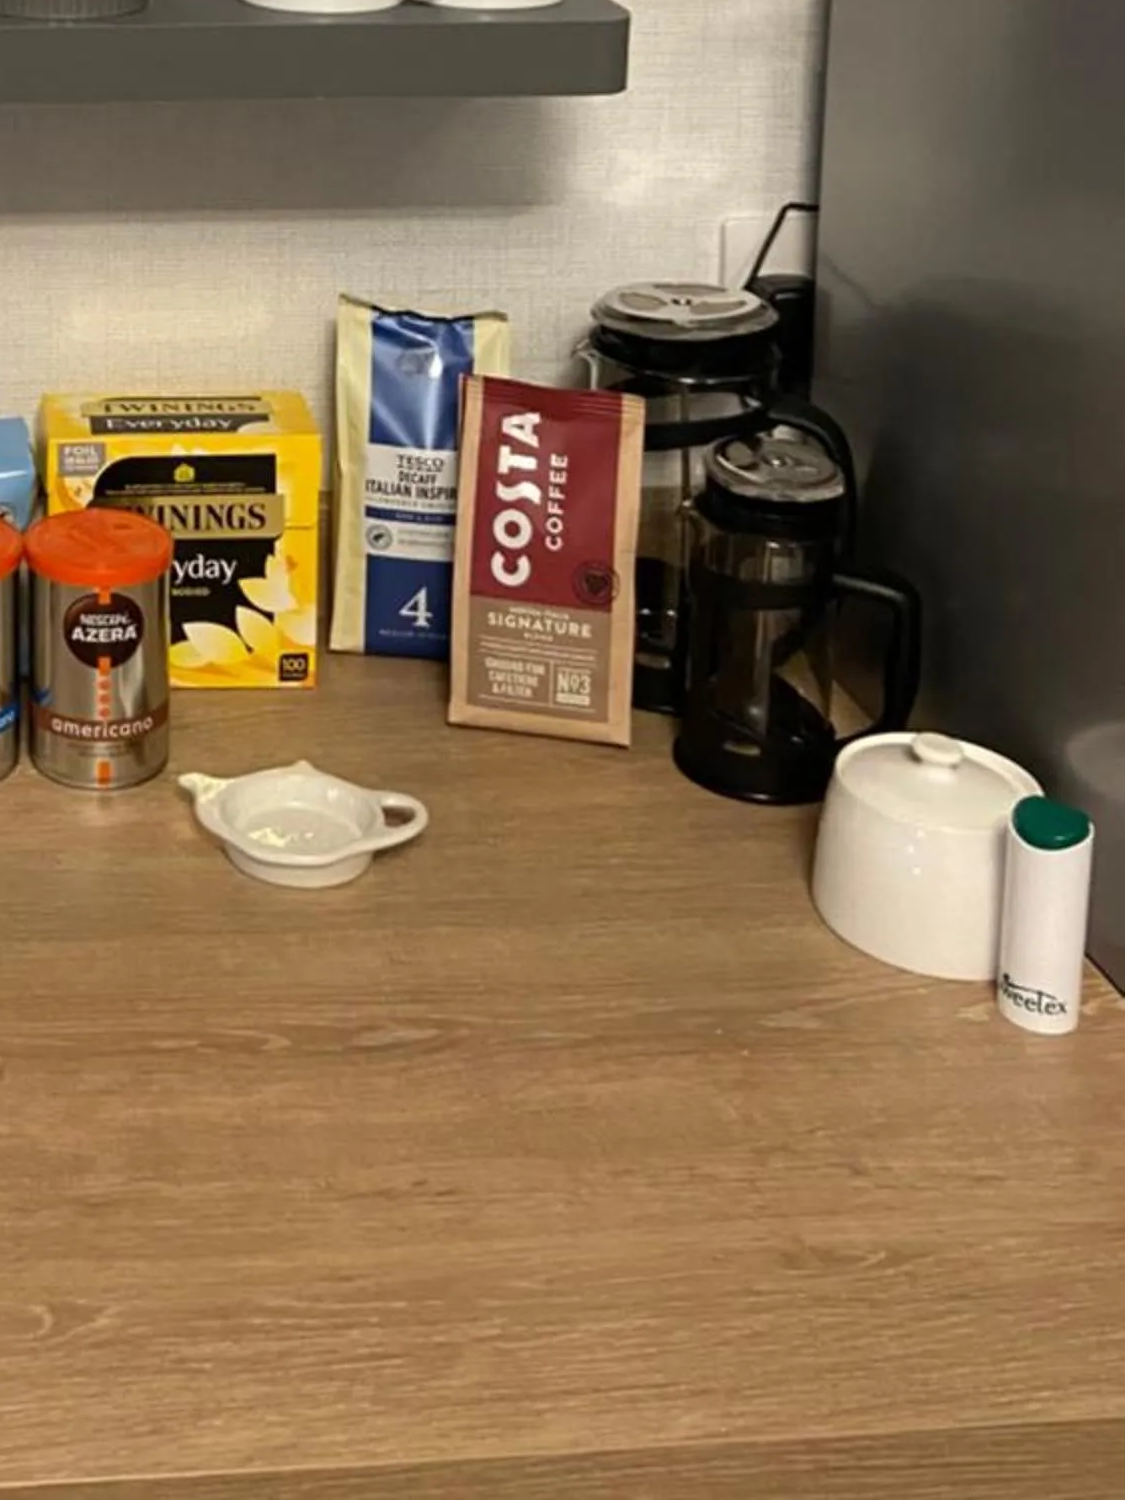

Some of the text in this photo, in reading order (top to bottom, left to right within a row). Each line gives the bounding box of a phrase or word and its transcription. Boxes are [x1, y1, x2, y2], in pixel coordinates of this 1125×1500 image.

[103, 401, 256, 414] TWININGS
[105, 417, 234, 431] Everyday
[396, 454, 444, 473] TESCO
[398, 470, 437, 485] DECAFF
[365, 479, 413, 498] ITALIAN
[490, 411, 542, 587] COSTA
[544, 453, 569, 552] COFFEE
[129, 503, 266, 531] ININGS
[173, 554, 237, 585] yday
[398, 585, 434, 630] 4
[71, 623, 137, 643] AZERA
[487, 611, 593, 639] SIGNATURE
[283, 658, 306, 671] 100
[51, 716, 154, 739] americano
